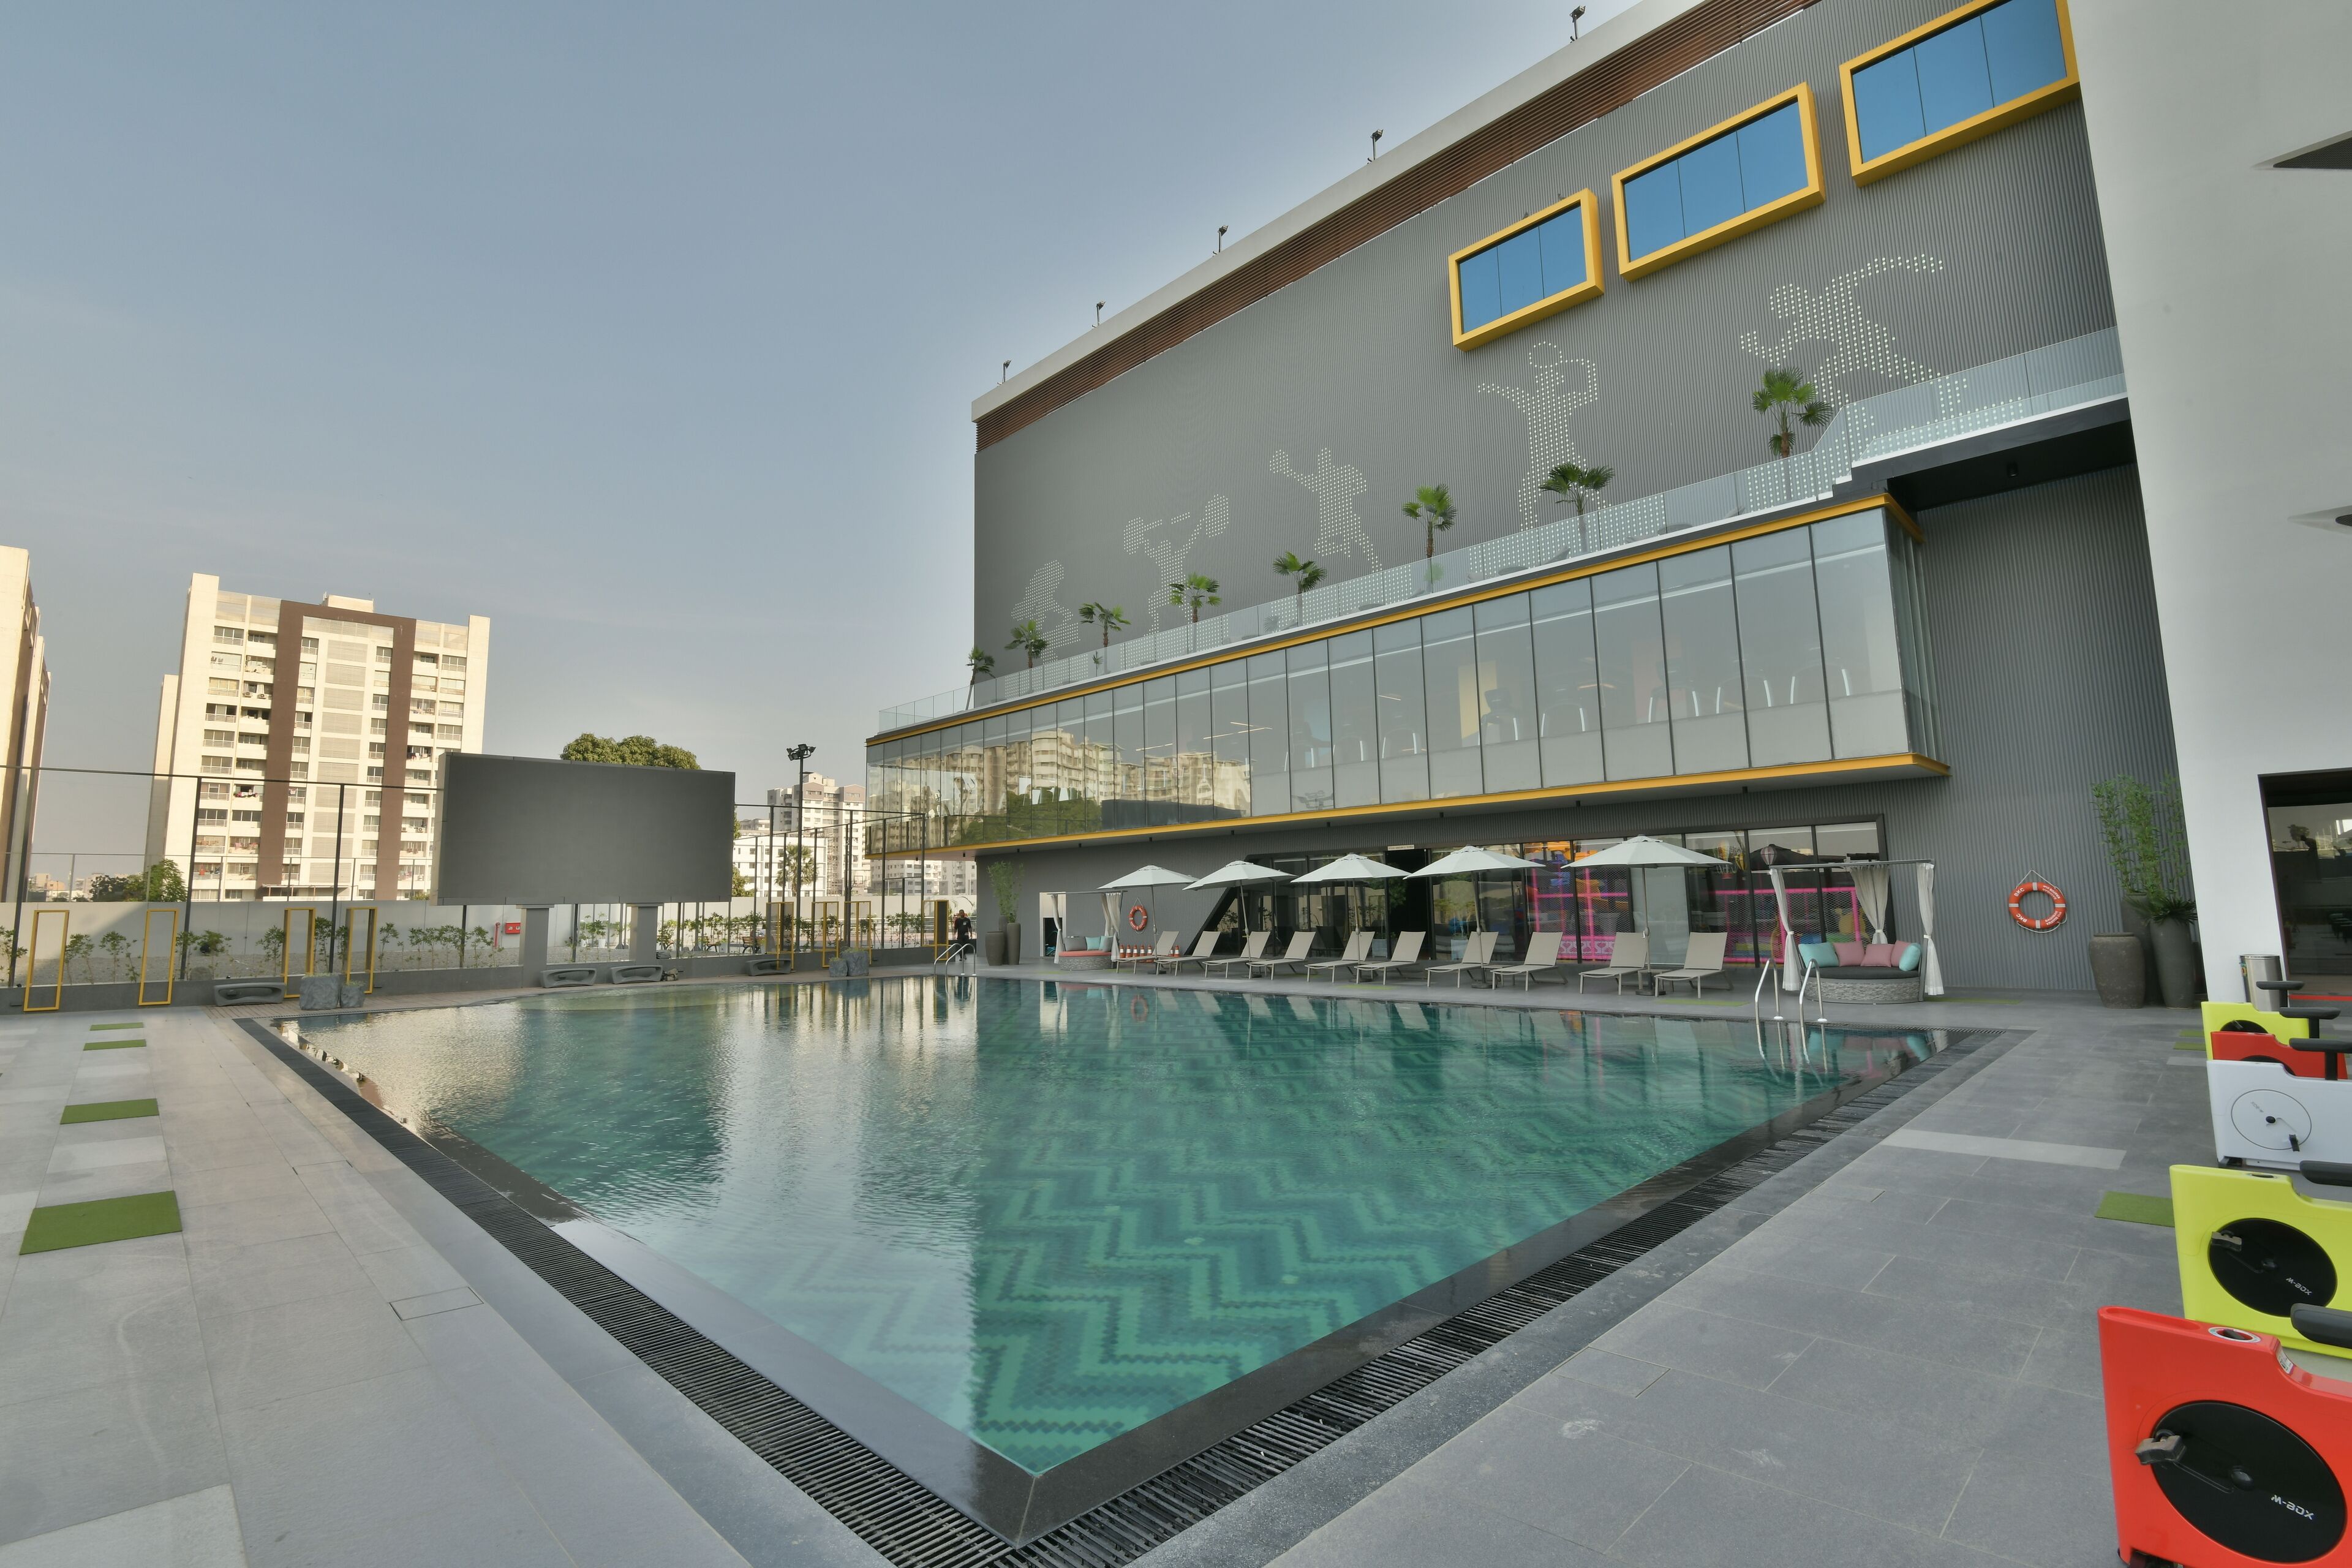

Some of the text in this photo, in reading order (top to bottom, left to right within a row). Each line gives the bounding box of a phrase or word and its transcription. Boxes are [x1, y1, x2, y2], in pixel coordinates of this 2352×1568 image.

[2014, 888, 2025, 897] BKC
[2016, 913, 2027, 923] BKC
[2285, 1277, 2313, 1295] M-BOX
[2271, 1494, 2315, 1520] M-BOX
